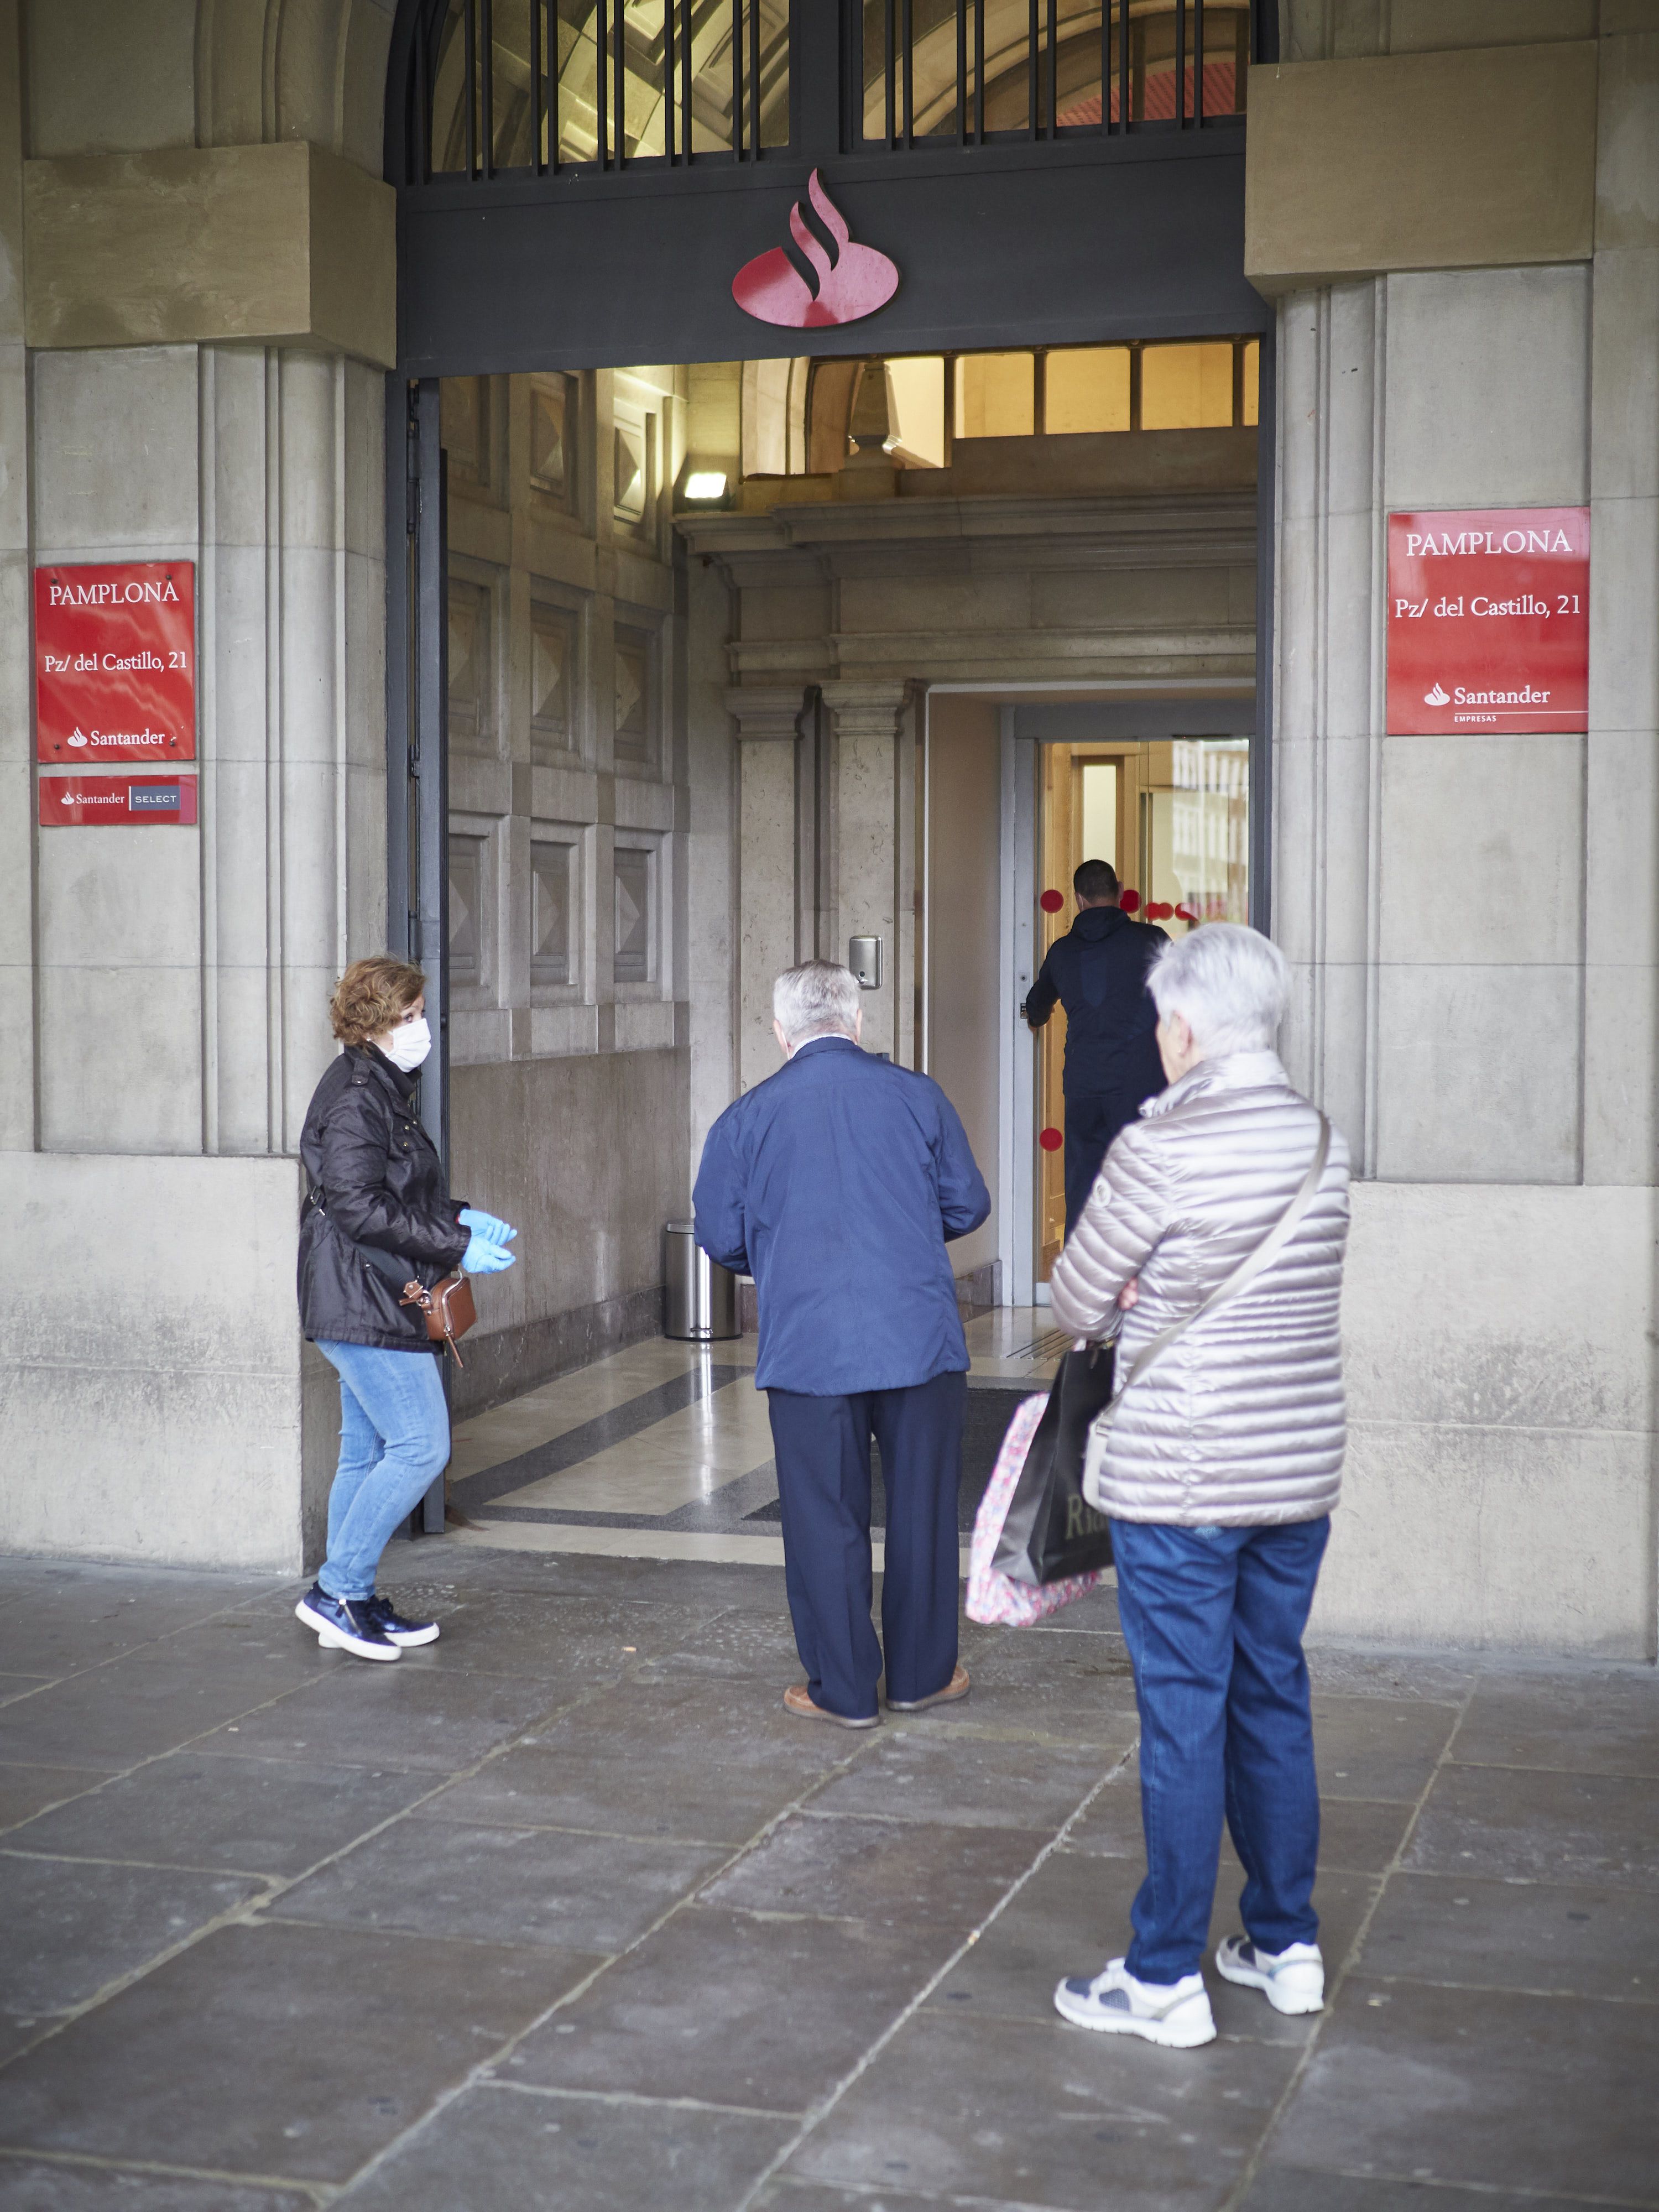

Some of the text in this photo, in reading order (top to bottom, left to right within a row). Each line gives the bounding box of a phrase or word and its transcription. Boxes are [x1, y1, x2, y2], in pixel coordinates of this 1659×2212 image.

[1406, 529, 1573, 556] PAMPLONA
[49, 581, 179, 606] PAMPLONA
[1395, 594, 1580, 619] Pz/ del Castillo, 21
[45, 651, 187, 673] Pz/ del Castillo, 21
[1454, 685, 1551, 705] Santander
[90, 728, 165, 746] Santander
[76, 793, 124, 804] Santander
